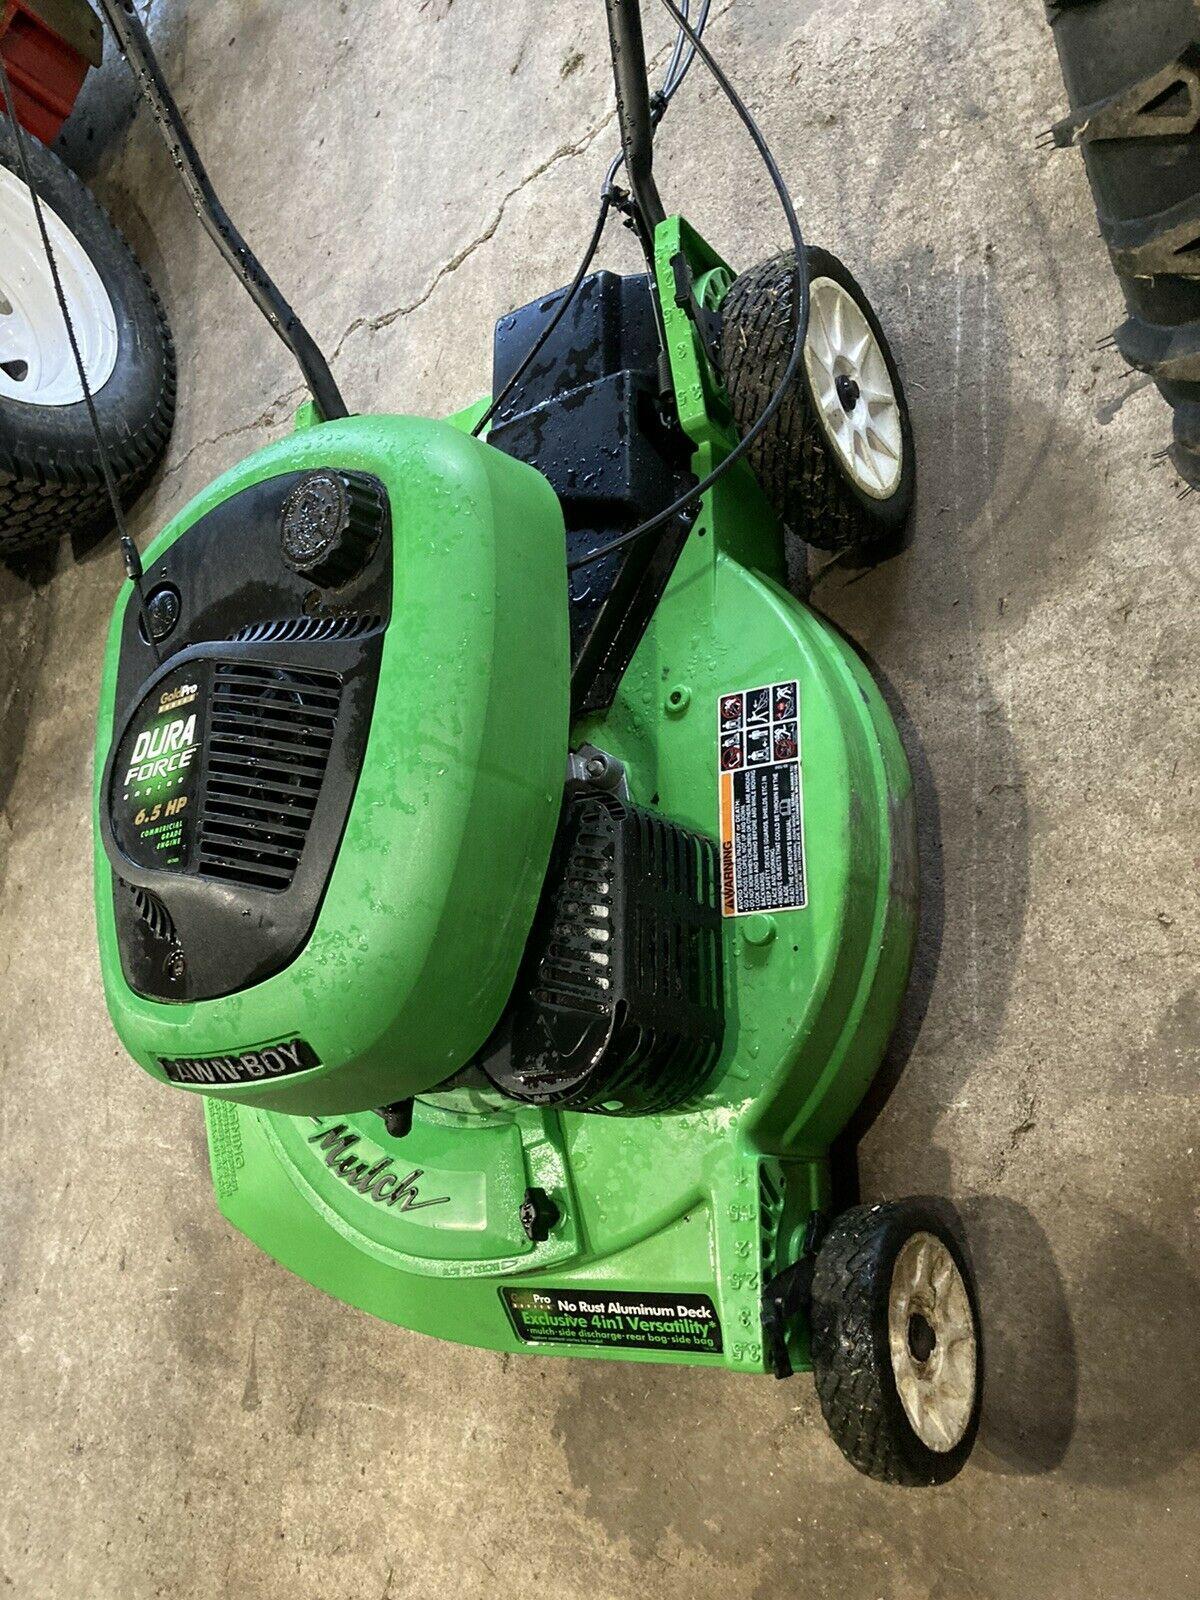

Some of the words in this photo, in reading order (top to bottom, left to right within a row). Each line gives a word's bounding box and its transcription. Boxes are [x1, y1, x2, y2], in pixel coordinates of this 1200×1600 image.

[160, 684, 198, 705] GoldPro
[130, 714, 197, 765] DURA
[123, 748, 197, 786] FORCE
[134, 803, 162, 826] 6.5
[164, 796, 188, 817] HP
[723, 840, 733, 899] WARNING
[308, 1123, 451, 1212] Mulch
[521, 1310, 588, 1328] Exclusive
[591, 1314, 624, 1330] 4in1
[557, 1300, 577, 1312] No
[579, 1301, 605, 1313] Rust
[608, 1302, 675, 1317] Aluminum
[677, 1305, 712, 1318] Deck
[693, 1335, 714, 1347] bag
